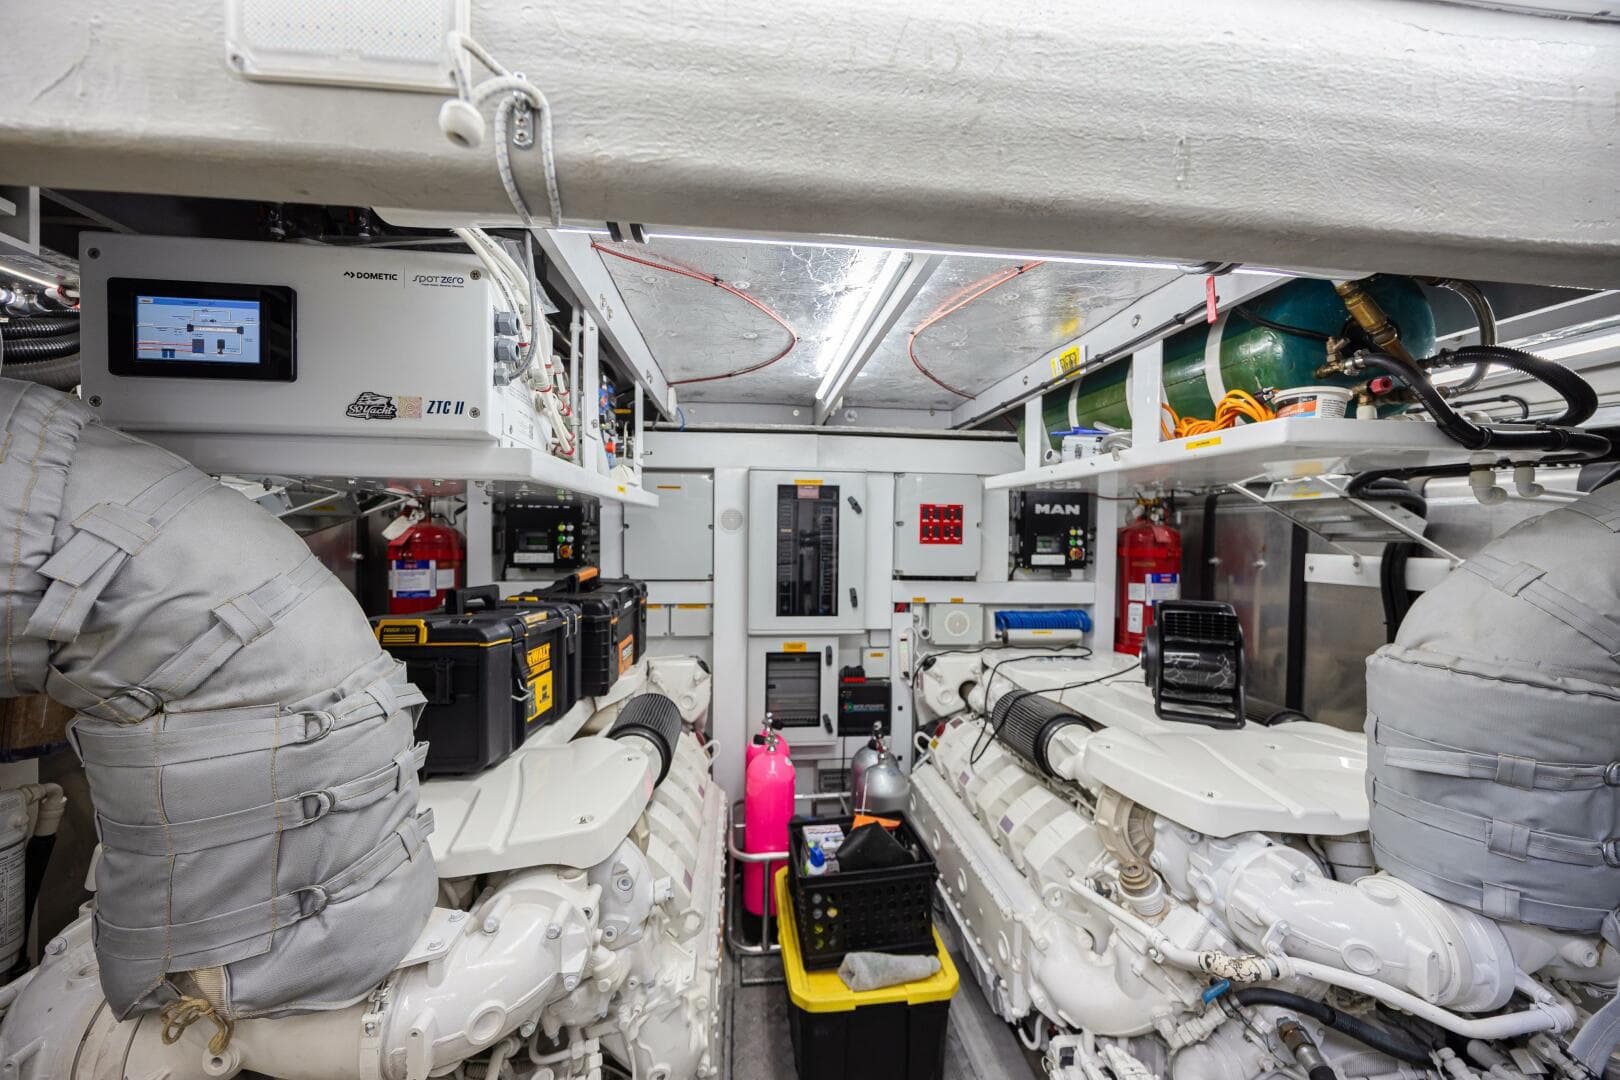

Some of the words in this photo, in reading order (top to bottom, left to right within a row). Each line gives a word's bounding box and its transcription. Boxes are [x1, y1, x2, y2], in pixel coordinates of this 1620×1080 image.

[356, 272, 398, 280] DOMETIC
[427, 400, 451, 414] ZTC
[455, 401, 464, 414] II
[1035, 504, 1080, 514] MAN
